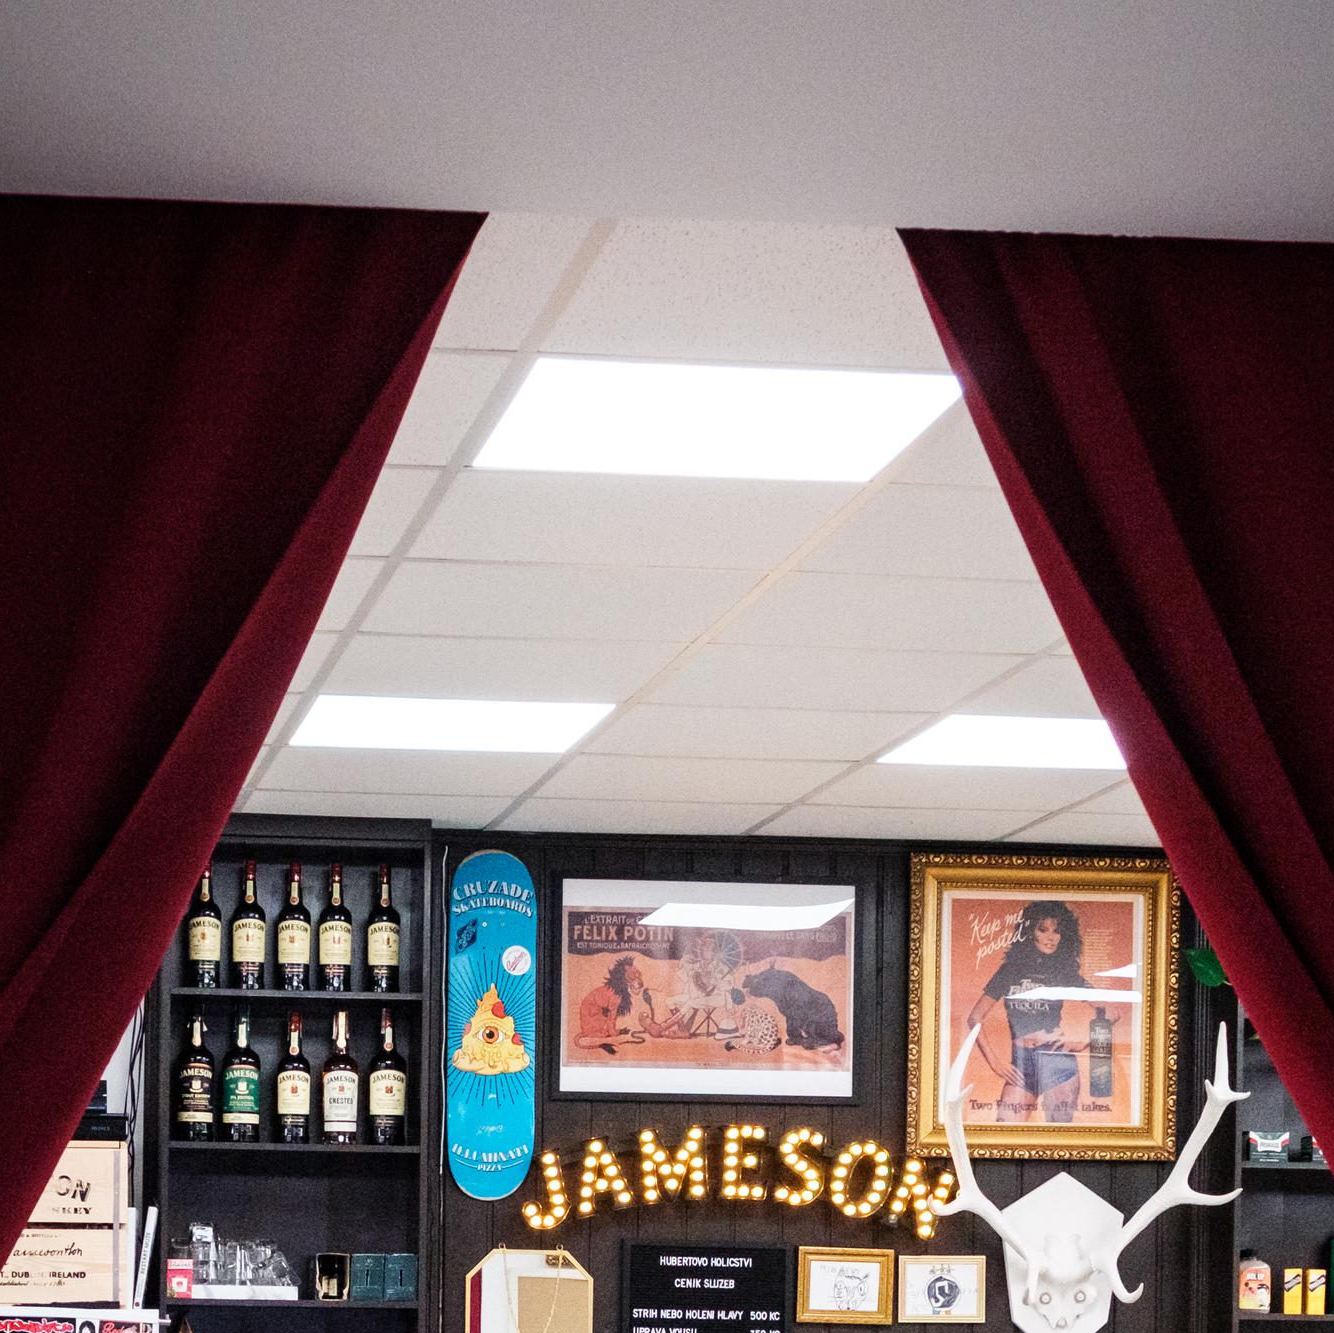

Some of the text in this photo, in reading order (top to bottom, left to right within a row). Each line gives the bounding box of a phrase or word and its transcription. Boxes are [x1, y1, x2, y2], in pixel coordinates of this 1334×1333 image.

[453, 880, 534, 905] CRUZADE
[452, 897, 533, 918] SKATEBOARDS
[1005, 909, 1024, 924] me
[234, 921, 265, 932] JAMESON
[278, 922, 309, 933] JAMESON
[320, 923, 352, 934] JAMESON
[370, 924, 400, 935] JAMESON
[624, 926, 674, 941] POTIN
[180, 1068, 212, 1080] JAMESON
[225, 1068, 259, 1080] JAMESON
[278, 1074, 309, 1084] JAMESON
[326, 1074, 357, 1084] JAMESON
[371, 1073, 405, 1083] JAMESON
[328, 1097, 354, 1105] CRESTED
[969, 1100, 992, 1111] Two
[452, 1143, 529, 1163] ILLUMINATI
[477, 1164, 502, 1172] PIZZA
[522, 1124, 956, 1240] JAMESON
[659, 1256, 753, 1268] HUBERTOVO HOLICSTVI
[49, 1271, 87, 1279] IRELAND
[674, 1278, 735, 1289] CENIK SLUZEB
[632, 1309, 781, 1321] STRIH NEBO HOLENI HLAVY 500 KC
